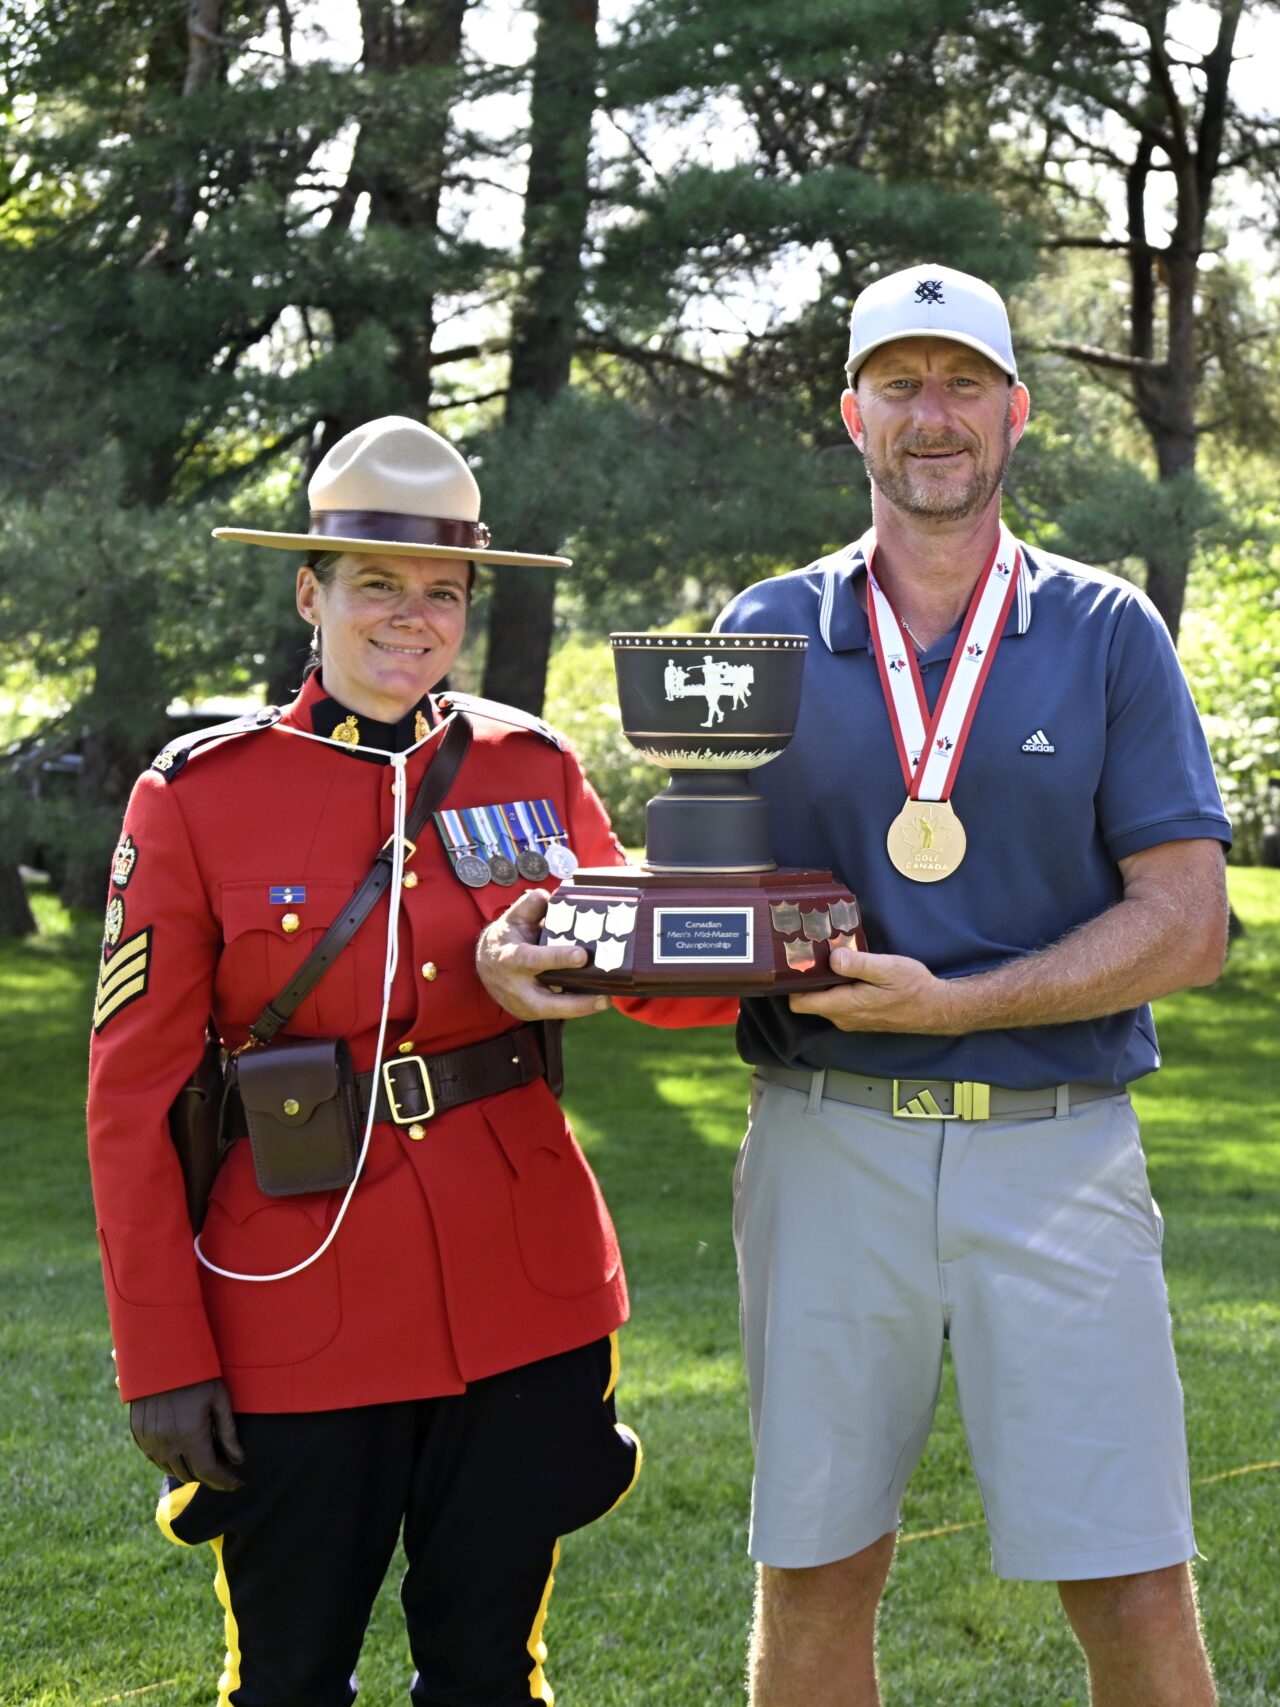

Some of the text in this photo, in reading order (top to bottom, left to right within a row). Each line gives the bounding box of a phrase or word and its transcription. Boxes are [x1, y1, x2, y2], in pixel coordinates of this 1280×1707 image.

[1022, 743, 1055, 753] adidas
[914, 854, 940, 862] GOLF
[905, 862, 948, 871] CANADA
[685, 920, 722, 929] Canadian
[694, 930, 740, 938] Mid-Master
[675, 941, 732, 950] Championship
